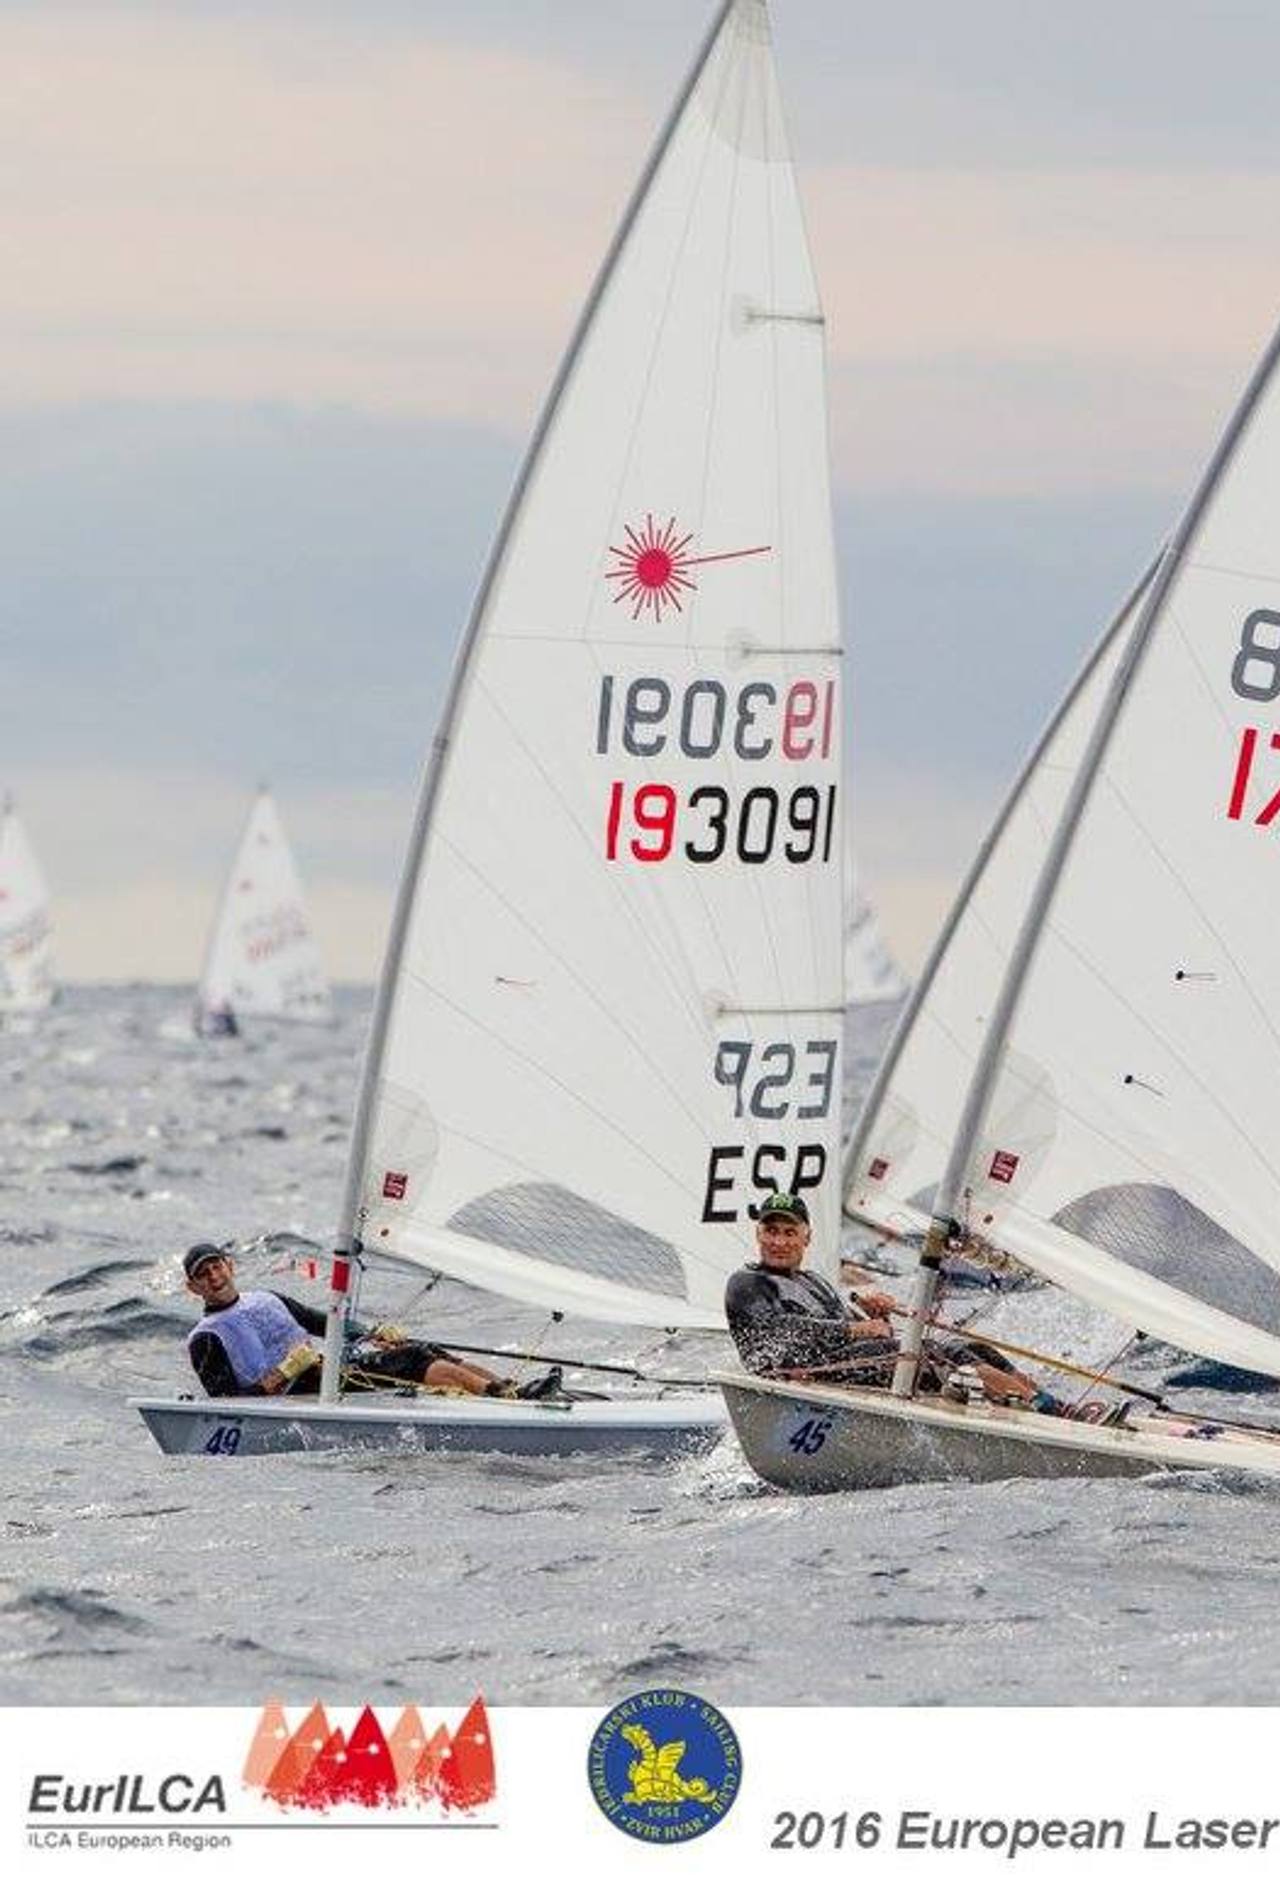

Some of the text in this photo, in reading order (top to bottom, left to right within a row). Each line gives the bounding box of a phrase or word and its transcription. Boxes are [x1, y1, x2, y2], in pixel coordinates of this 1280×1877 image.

[606, 782, 836, 863] 193091
[702, 1143, 826, 1223] ESP
[206, 1427, 241, 1456] 49
[789, 1420, 832, 1455] 45
